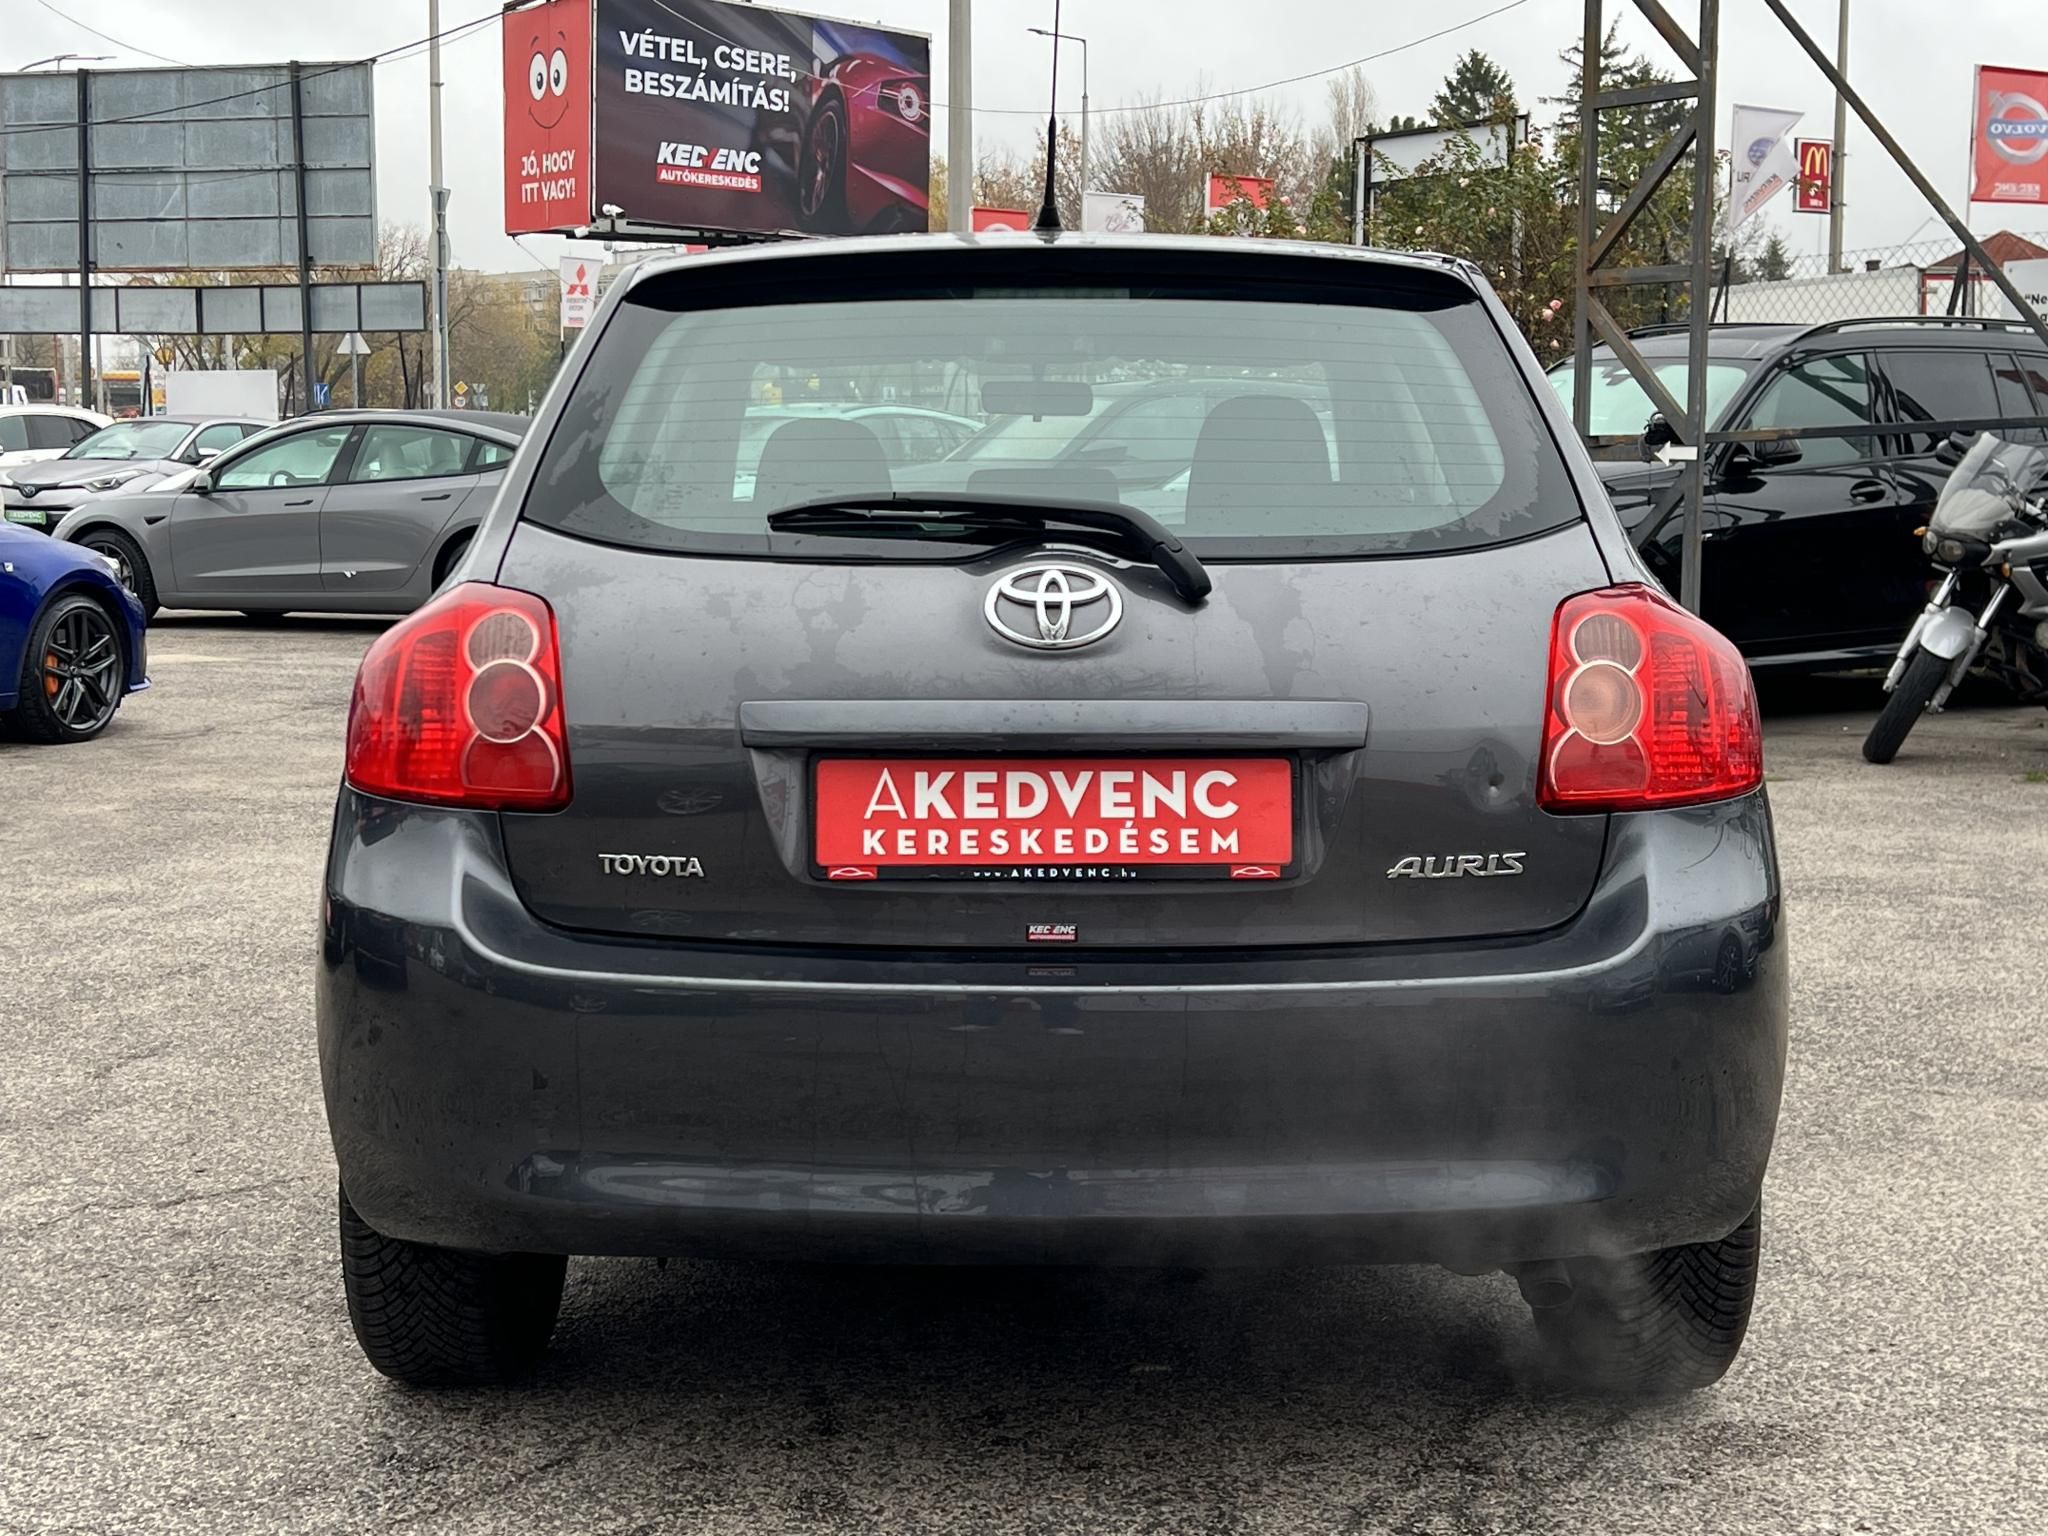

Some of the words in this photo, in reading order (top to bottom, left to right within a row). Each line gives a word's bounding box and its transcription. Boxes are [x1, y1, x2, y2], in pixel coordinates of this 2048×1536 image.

[619, 28, 708, 70] VÉTEL,
[714, 45, 797, 83] CSERE,
[625, 69, 790, 113] BESZÁMÍTÁS!
[521, 150, 540, 178] JÓ,
[542, 149, 576, 173] HOGY
[521, 183, 540, 204] ITT
[541, 178, 576, 201] VAGY!
[660, 169, 758, 190] AUTÓKERESKEDÉS
[863, 767, 1239, 820] AKEDVENC
[863, 821, 1240, 856] KERESKEDÉSEM
[598, 853, 705, 877] TOYOTA
[1386, 852, 1526, 879] AURIS
